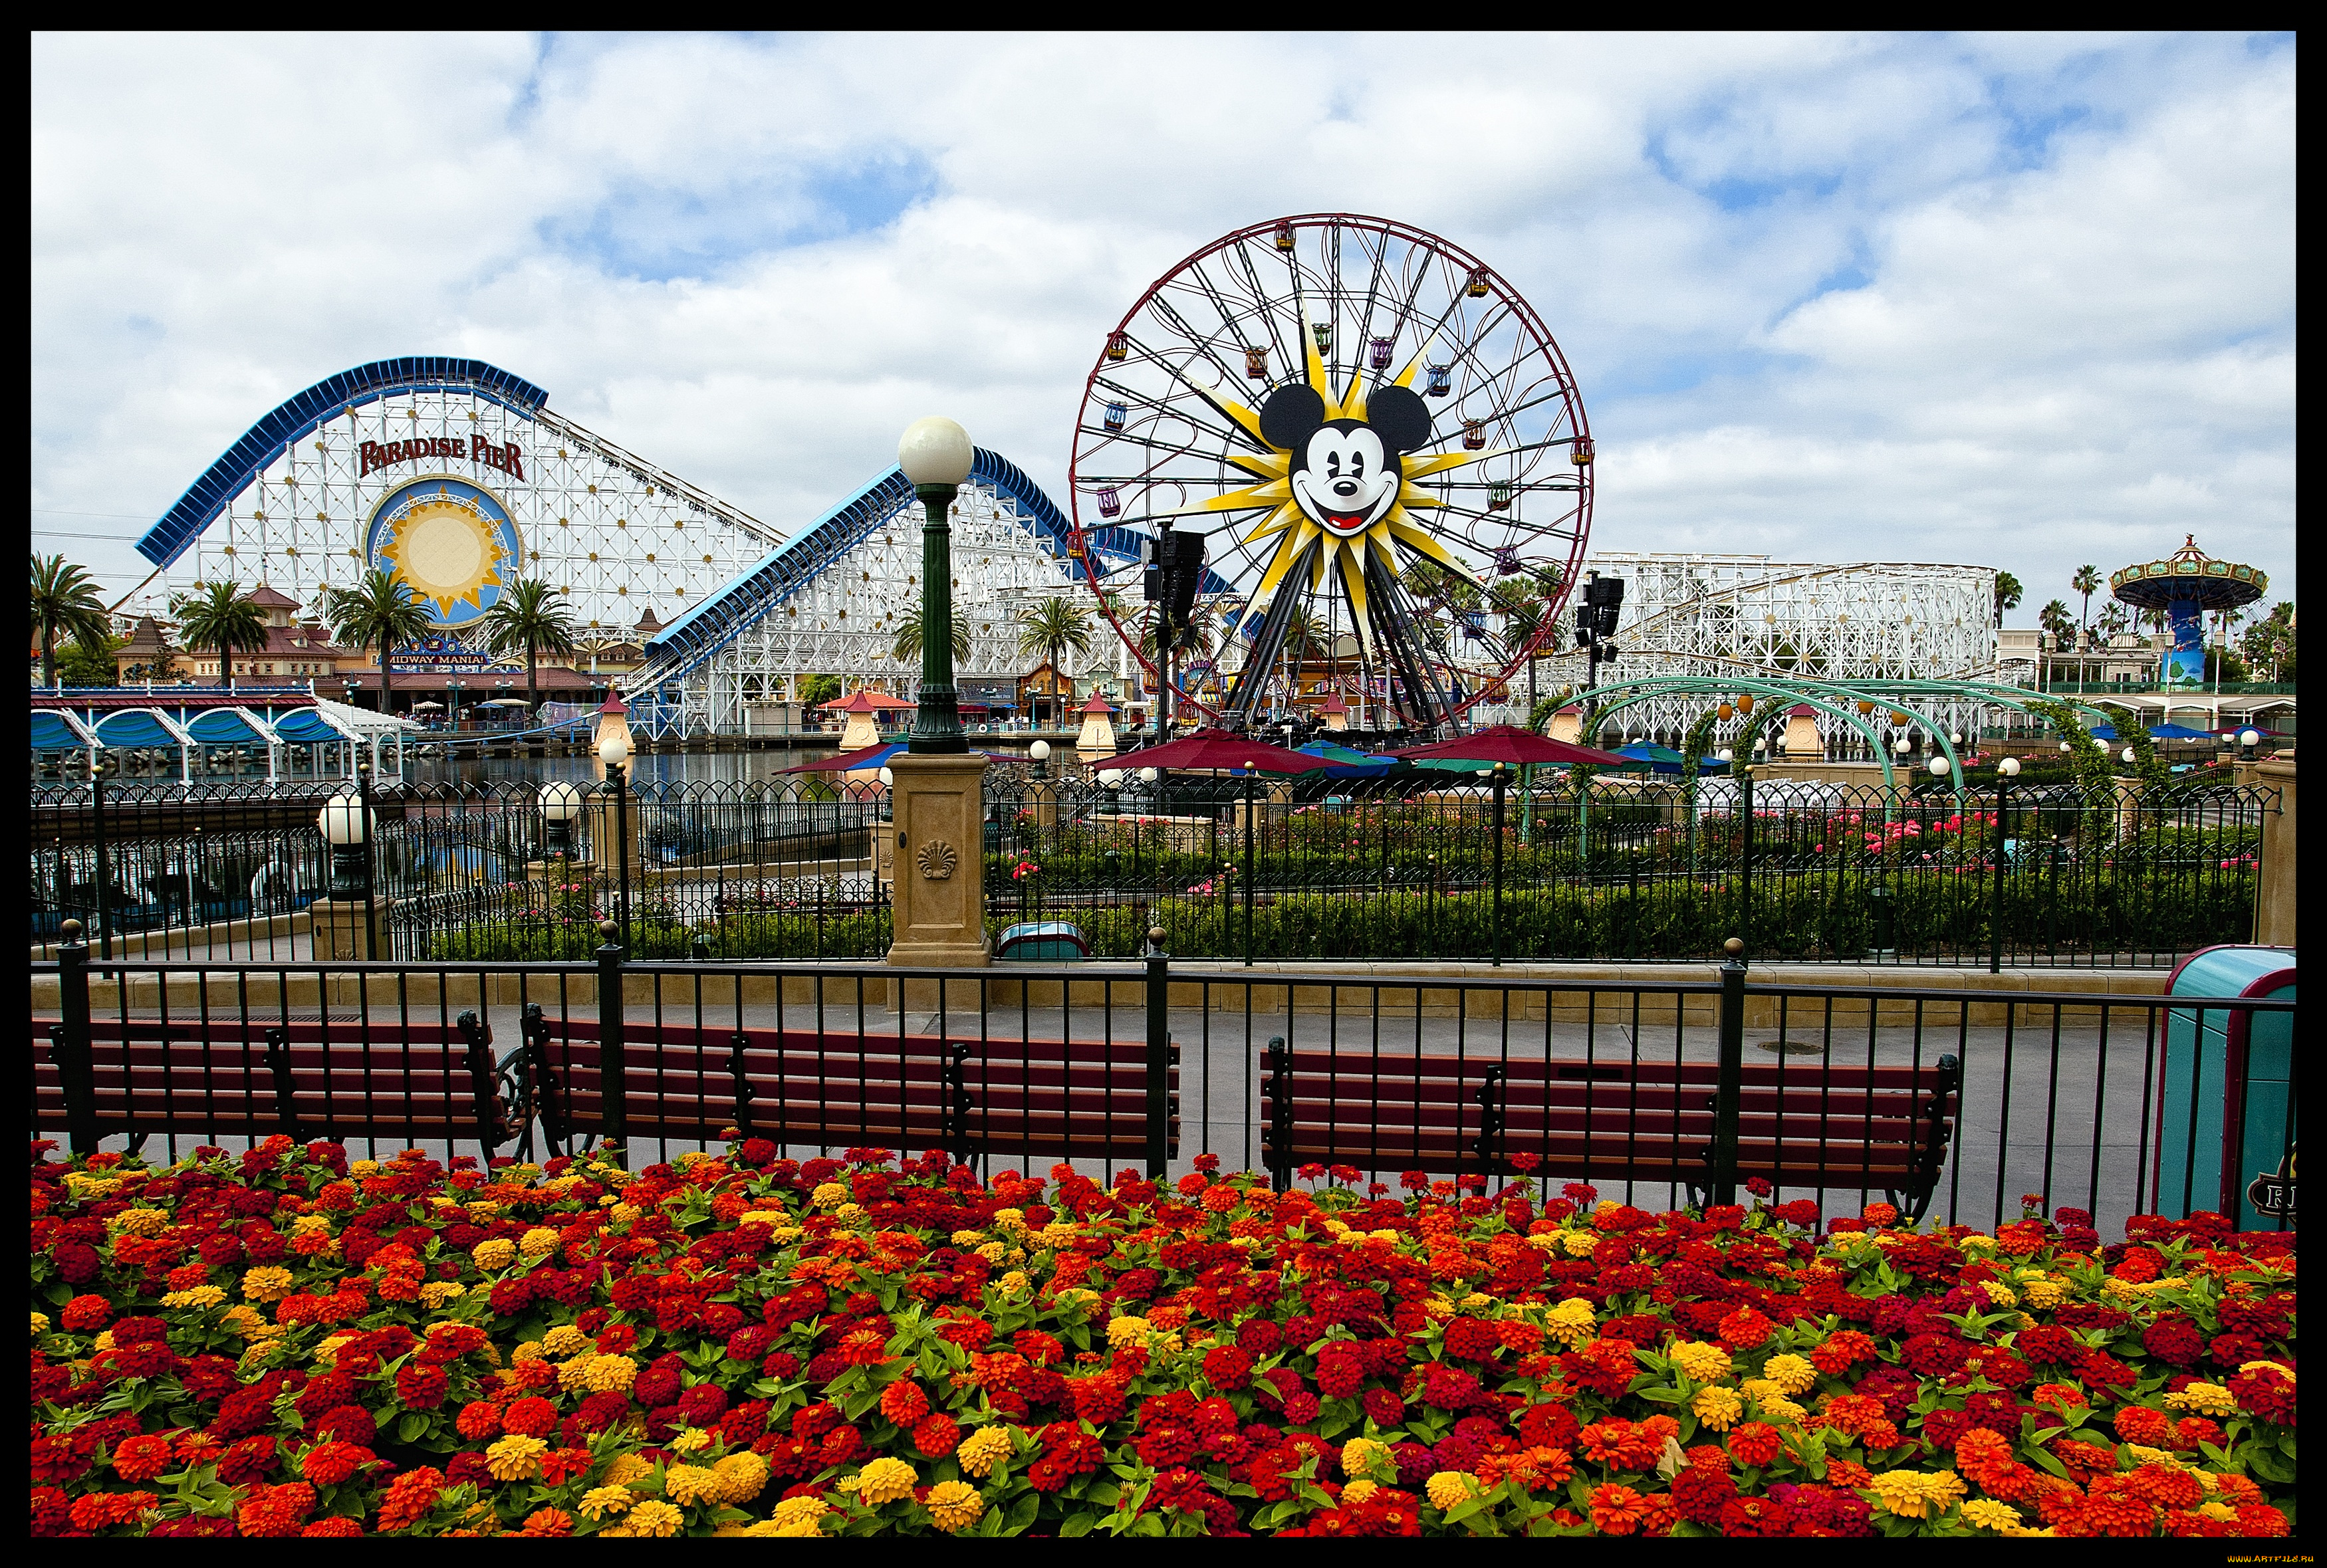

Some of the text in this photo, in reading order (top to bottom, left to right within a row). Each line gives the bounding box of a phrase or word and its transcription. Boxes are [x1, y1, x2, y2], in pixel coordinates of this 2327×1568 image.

[359, 433, 525, 483] PARADISE PIER
[439, 655, 484, 664] MANIA!
